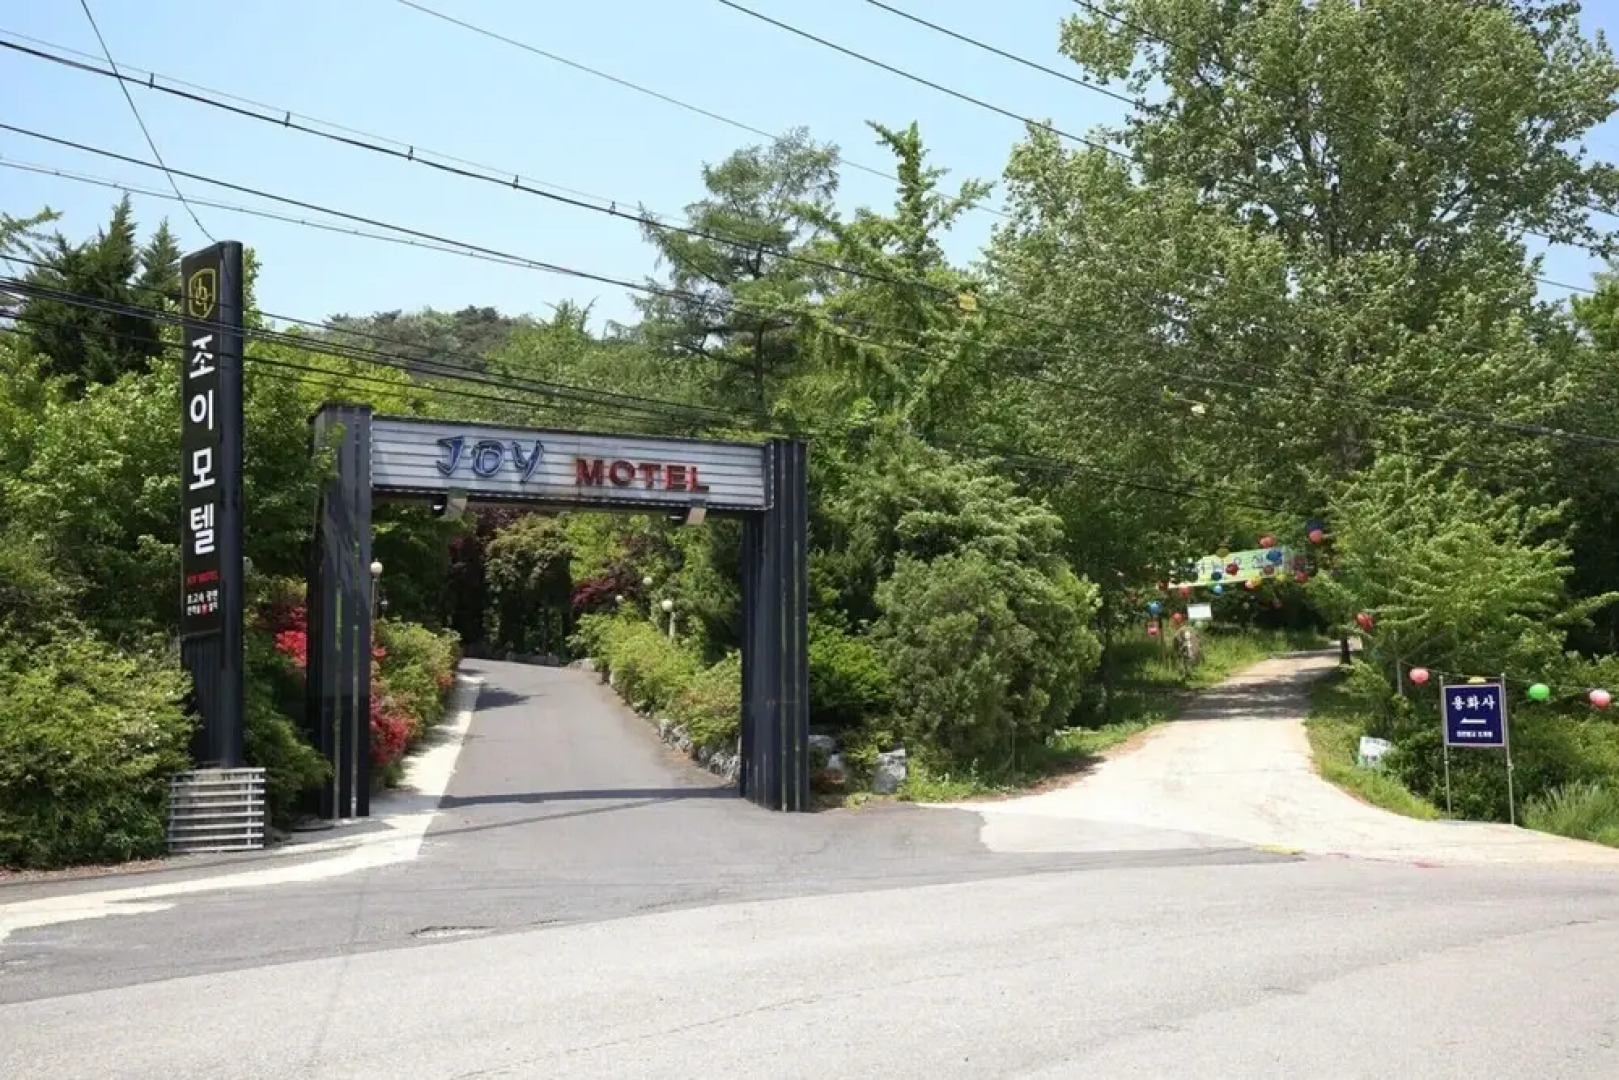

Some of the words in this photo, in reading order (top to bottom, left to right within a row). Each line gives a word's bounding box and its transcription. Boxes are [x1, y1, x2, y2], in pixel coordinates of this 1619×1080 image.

[188, 334, 216, 555] 조이모텔
[436, 435, 545, 484] JOY
[575, 458, 709, 493] MOTEL
[1451, 694, 1496, 711] 용화사
